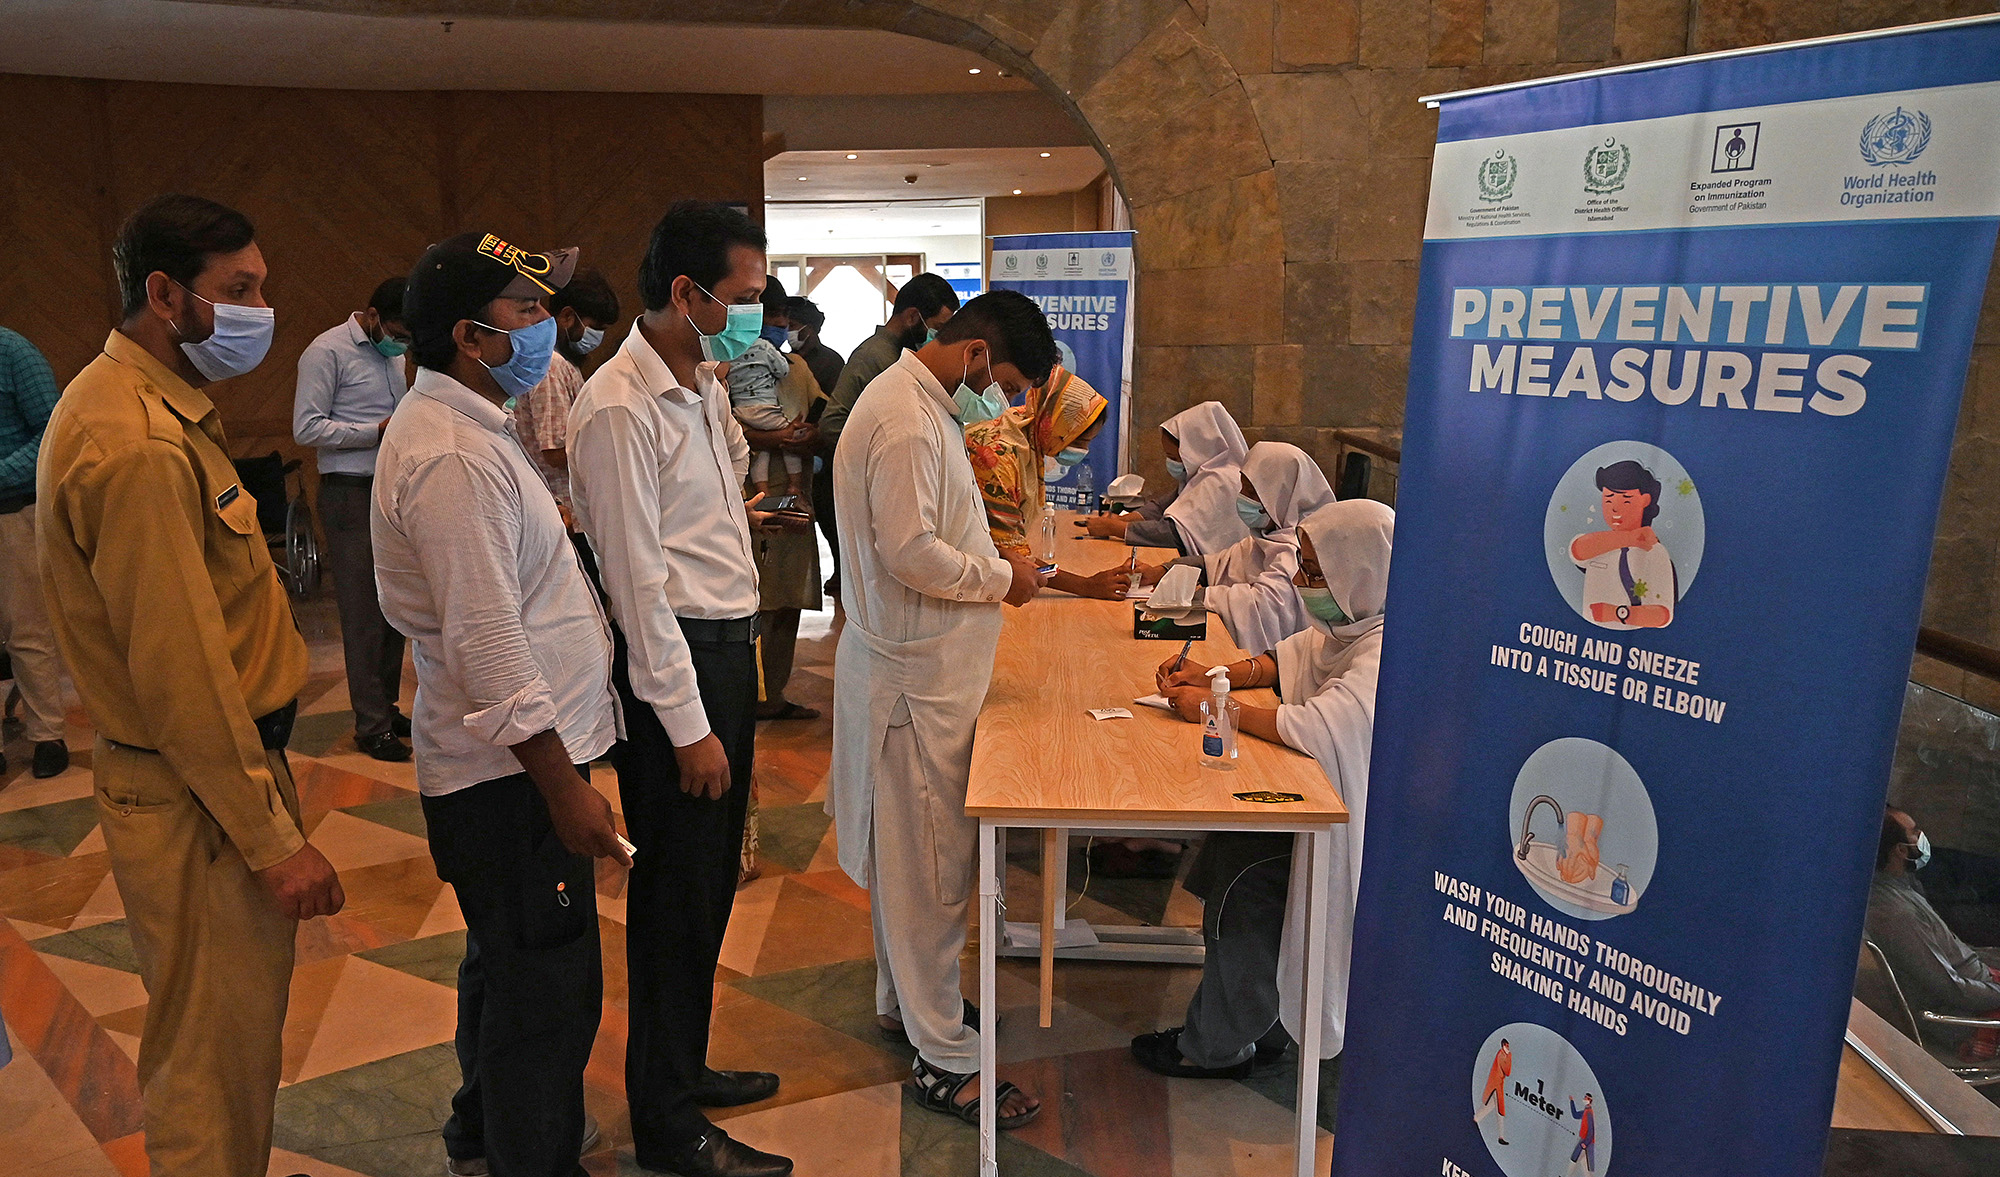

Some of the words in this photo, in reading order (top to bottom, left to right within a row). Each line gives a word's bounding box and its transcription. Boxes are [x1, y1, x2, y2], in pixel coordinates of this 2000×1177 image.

[1690, 180, 1732, 191] Expanded
[1734, 178, 1772, 188] Program
[1844, 174, 1884, 189] World
[1888, 170, 1937, 187] Health
[1689, 203, 1728, 213] Government
[1729, 202, 1737, 211] of
[1737, 201, 1767, 210] Pakistan
[1707, 190, 1765, 200] Immunization
[1840, 188, 1935, 208] Organization
[1030, 296, 1116, 313] VENTIVE
[1450, 286, 1925, 348] PREVENTIVE
[1046, 314, 1109, 331] SURES
[1469, 344, 1872, 417] MEASURES
[1519, 622, 1577, 655] COUGH
[1581, 638, 1622, 665] AND
[1627, 647, 1700, 685] SNEEZE
[1491, 645, 1532, 672] INTO
[1536, 656, 1548, 678] A
[1553, 659, 1617, 695] TISSUE
[1622, 677, 1648, 704] OR
[1652, 685, 1726, 724] ELBOW
[1433, 870, 1481, 907] WASH
[1485, 891, 1526, 928] YOUR
[1530, 913, 1590, 957] HANDS
[1595, 941, 1722, 1016] THOROUGHLY
[1443, 903, 1478, 932] AND
[1480, 919, 1585, 983] FREQUENTLY
[1588, 971, 1626, 1004] AND
[1630, 991, 1691, 1036] AVOID
[1490, 952, 1564, 1004] SHAKING
[1567, 988, 1628, 1036] HANDS
[1514, 1081, 1564, 1121] Meter
[1537, 1079, 1545, 1095] 1
